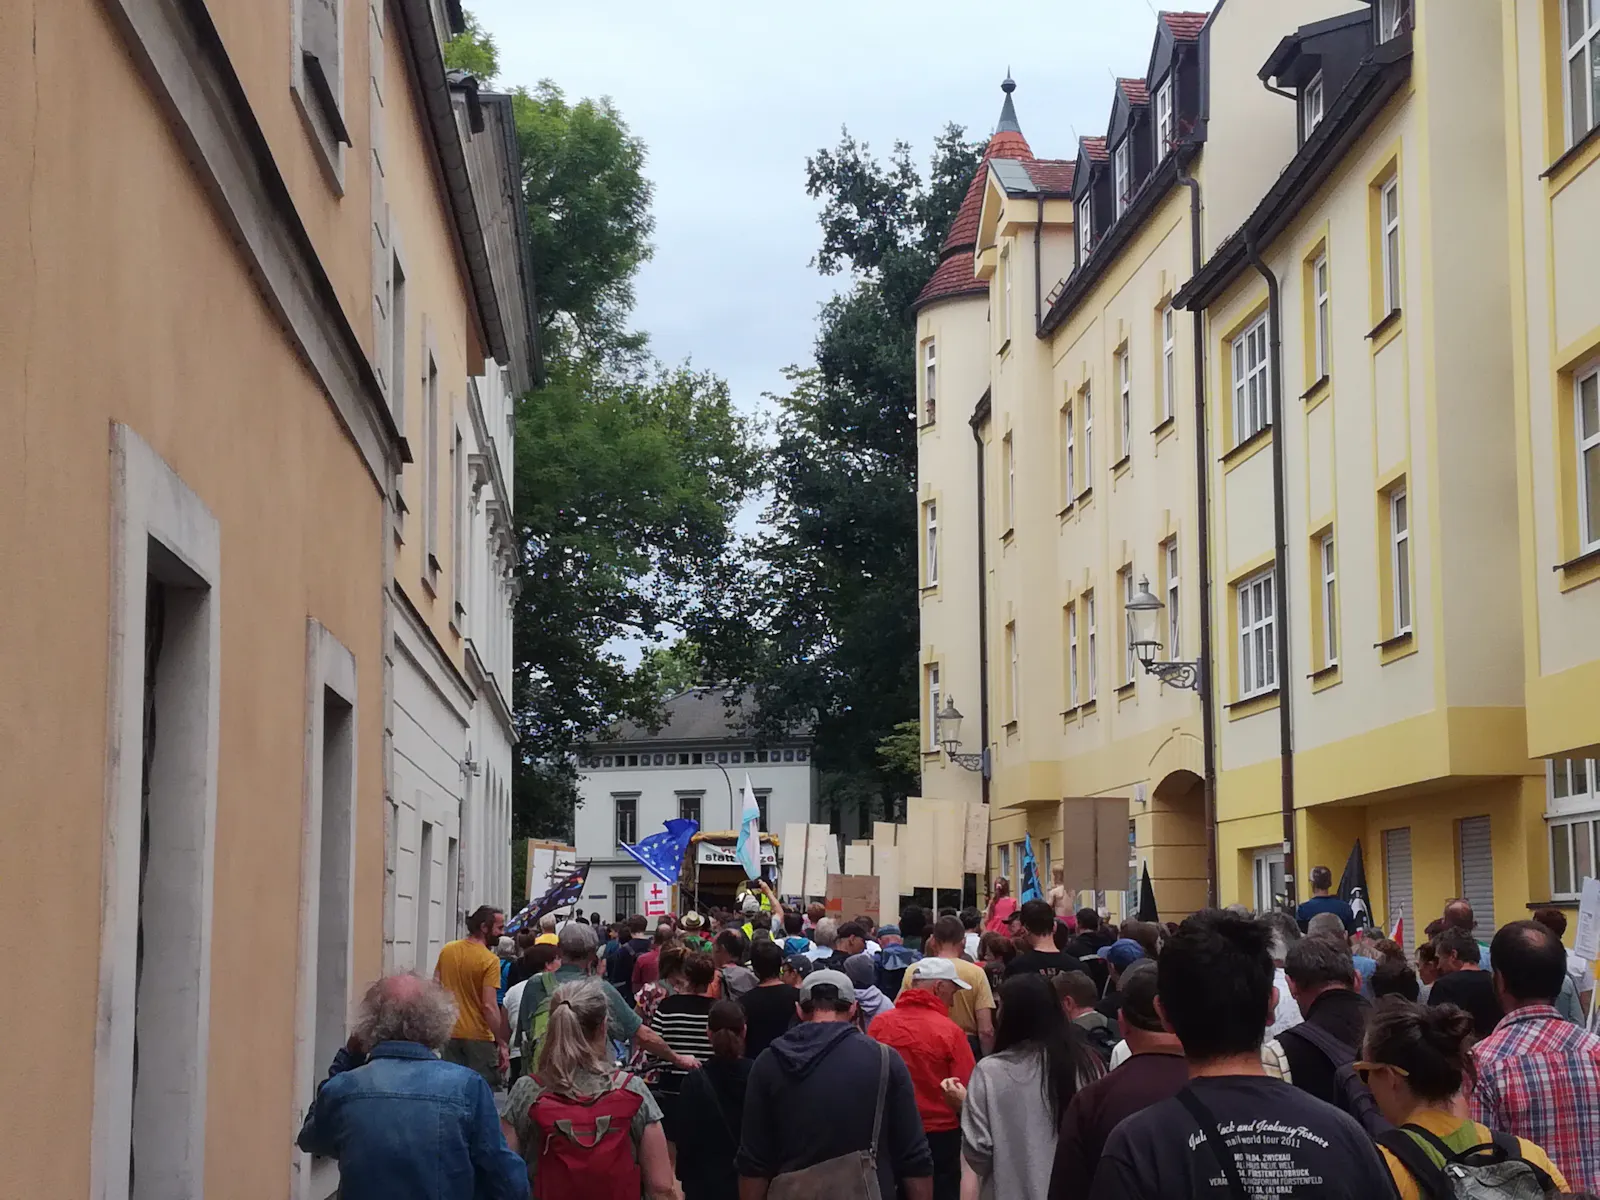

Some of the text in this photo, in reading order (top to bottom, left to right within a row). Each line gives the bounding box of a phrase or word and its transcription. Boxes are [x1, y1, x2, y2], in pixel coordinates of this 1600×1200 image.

[1236, 1119, 1257, 1133] and
[1256, 1119, 1299, 1140] Jealousy
[1240, 1134, 1262, 1145] world
[1263, 1135, 1279, 1145] tour
[1280, 1136, 1301, 1149] 2011
[1262, 1152, 1292, 1162] ZWICKAU
[1260, 1161, 1278, 1170] NEUE
[1278, 1161, 1295, 1170] WELT
[1276, 1185, 1293, 1194] GRAZ
